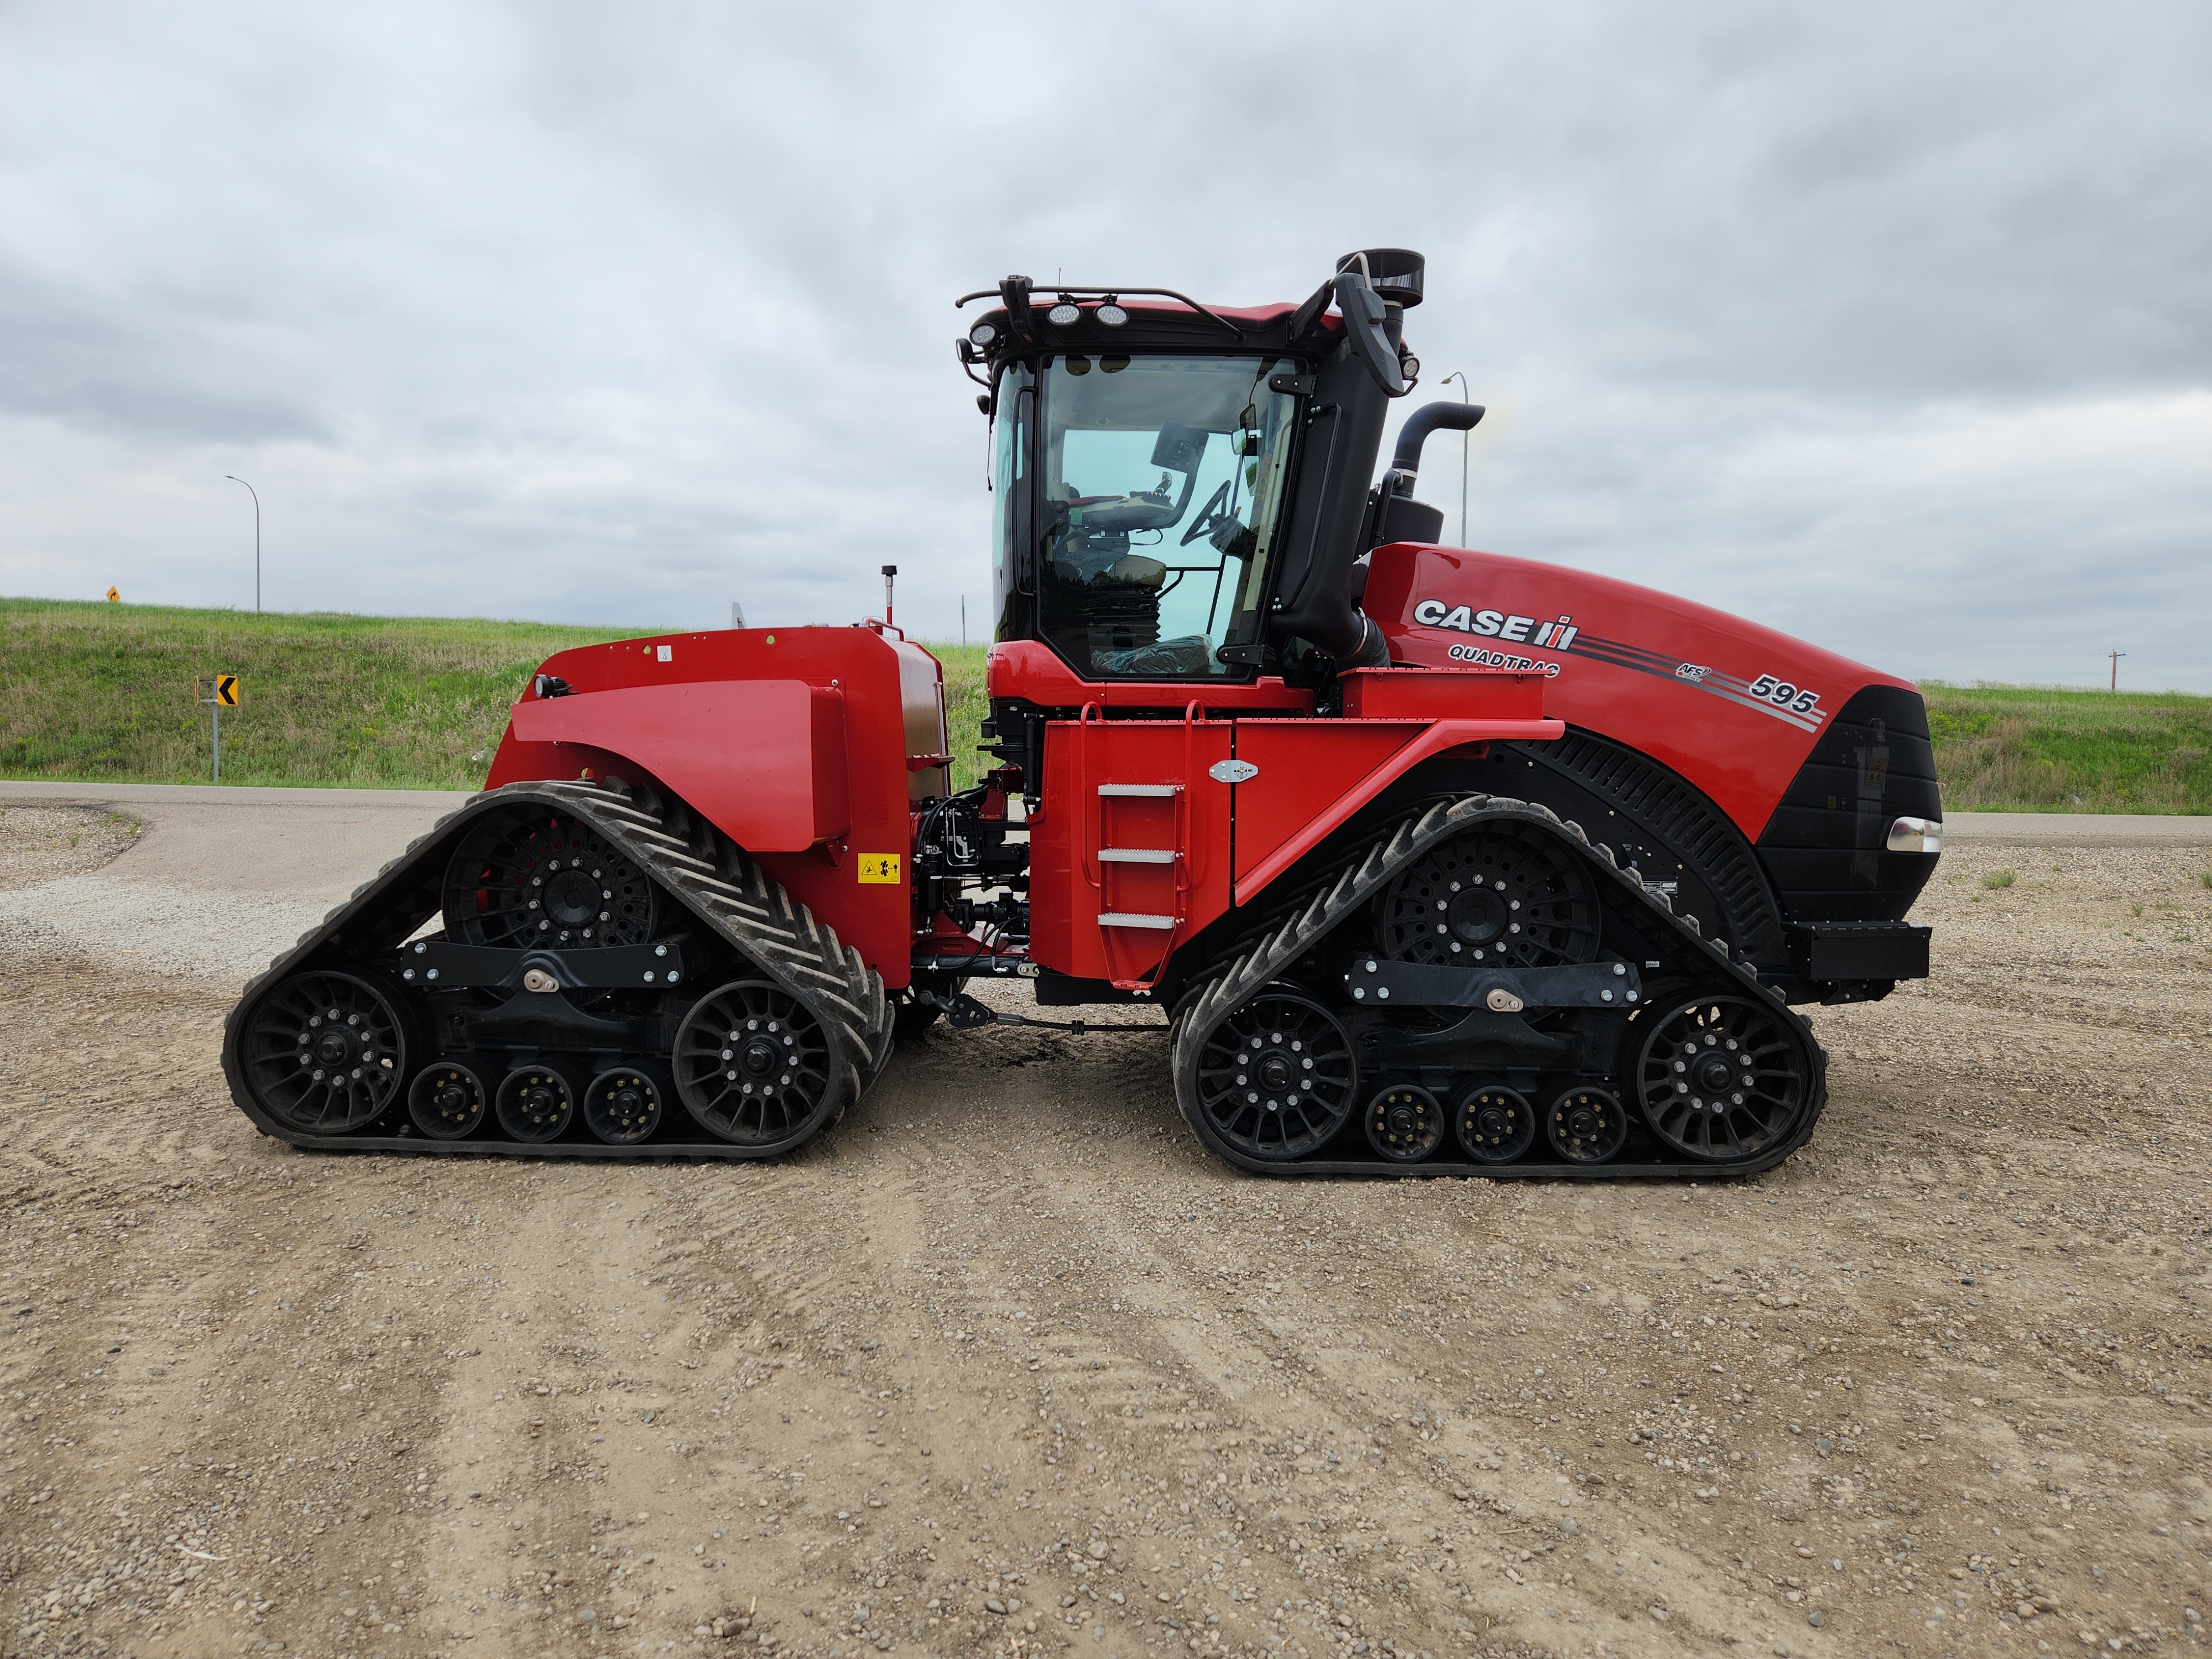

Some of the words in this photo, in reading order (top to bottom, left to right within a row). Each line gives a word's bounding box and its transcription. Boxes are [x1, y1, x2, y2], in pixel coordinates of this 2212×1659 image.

[1414, 599, 1535, 642] CASE
[1677, 664, 1704, 676] AFS
[1749, 674, 1820, 713] 595
